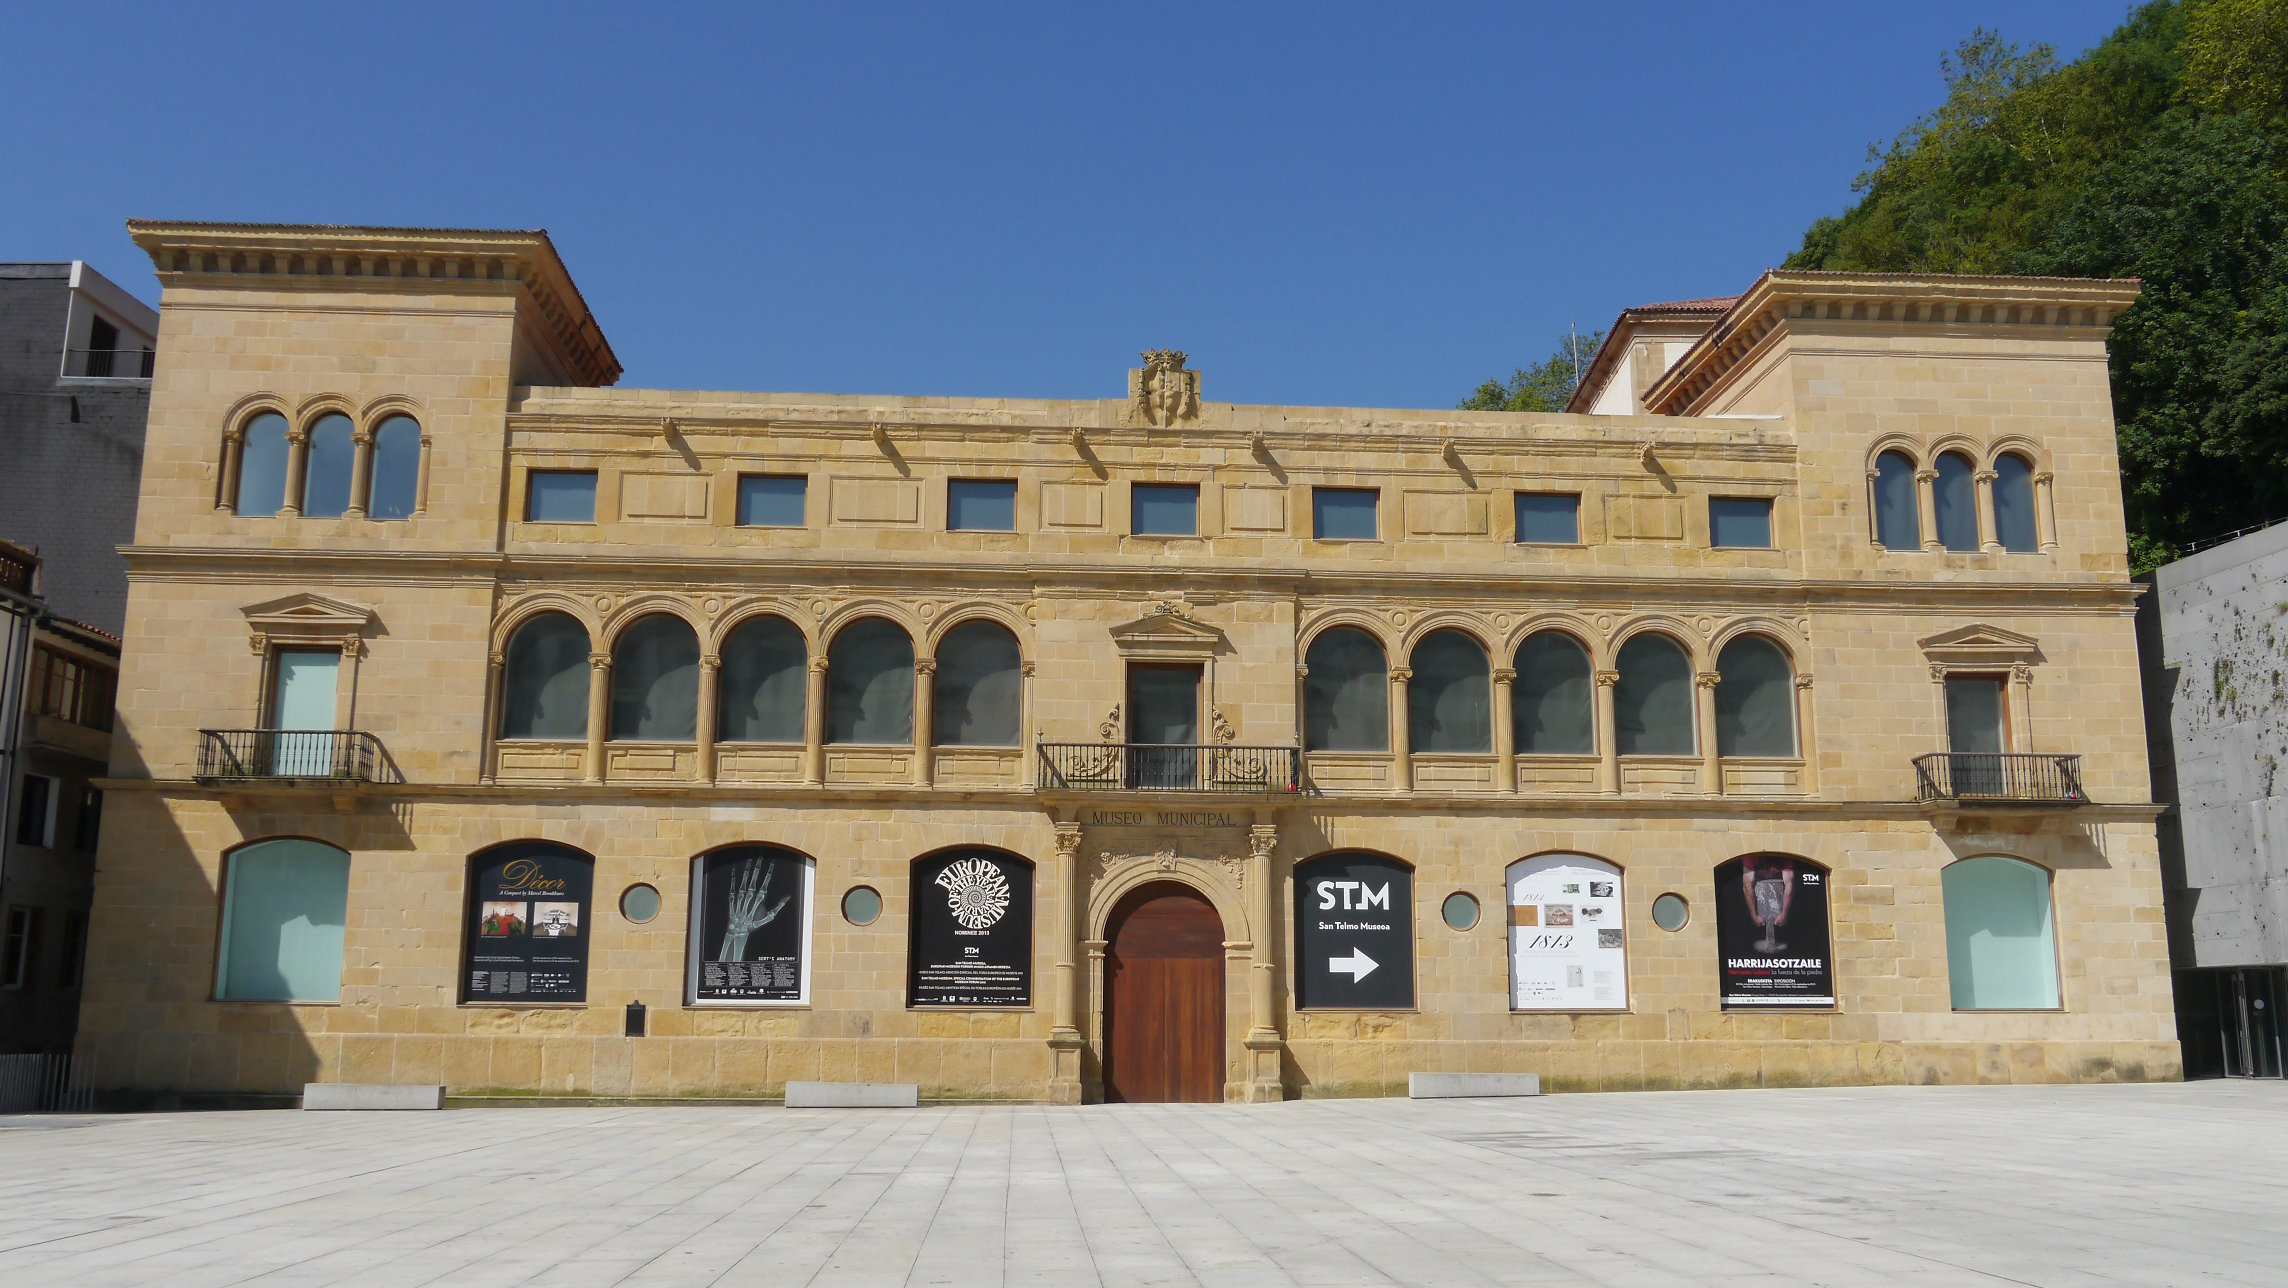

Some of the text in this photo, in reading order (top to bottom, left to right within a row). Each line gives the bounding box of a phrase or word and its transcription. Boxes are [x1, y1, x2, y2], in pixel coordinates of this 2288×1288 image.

[1092, 811, 1236, 826] MUSEO MUNICIPAL
[499, 859, 566, 890] Décor
[934, 858, 1010, 897] EUROPEAN
[954, 875, 975, 892] THE
[976, 875, 996, 896] YEAR
[948, 890, 961, 908] OF
[1317, 880, 1390, 910] STM
[952, 898, 1010, 929] MUSEUM
[965, 896, 995, 915] AWARD
[1319, 922, 1390, 930] San Telmo Museoa
[1529, 934, 1573, 949] 1813
[1728, 958, 1822, 968] HARRIJASOTZAILE
